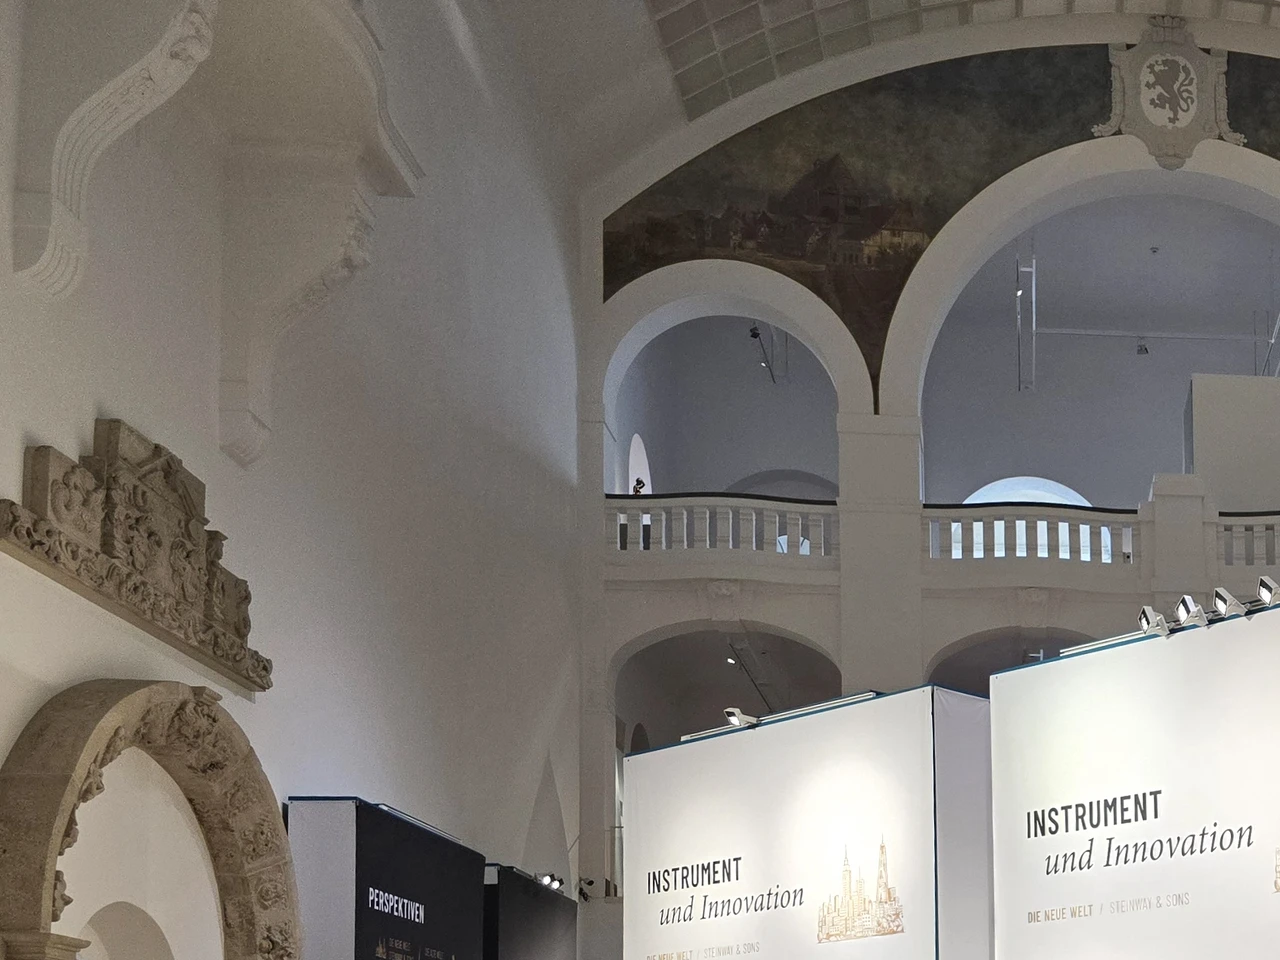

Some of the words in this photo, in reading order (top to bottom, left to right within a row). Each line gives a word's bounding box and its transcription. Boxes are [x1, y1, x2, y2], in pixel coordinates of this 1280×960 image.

[1027, 790, 1162, 838] INSTRUMENT
[1045, 838, 1094, 875] und
[1103, 822, 1254, 867] Innovation
[648, 857, 742, 894] INSTRUMENT
[369, 887, 424, 924] PERSPEKTIVEN
[660, 895, 694, 925] und
[700, 884, 804, 920] Innovation
[1028, 911, 1041, 923] DIE
[1044, 908, 1066, 922] NEUE
[1070, 905, 1093, 918] WELT
[1110, 900, 1152, 914] STEINWAY
[1156, 896, 1162, 908] &
[1166, 893, 1189, 906] SONS
[704, 946, 733, 958] STEINWAY
[736, 944, 740, 954] &
[743, 942, 760, 953] SONS
